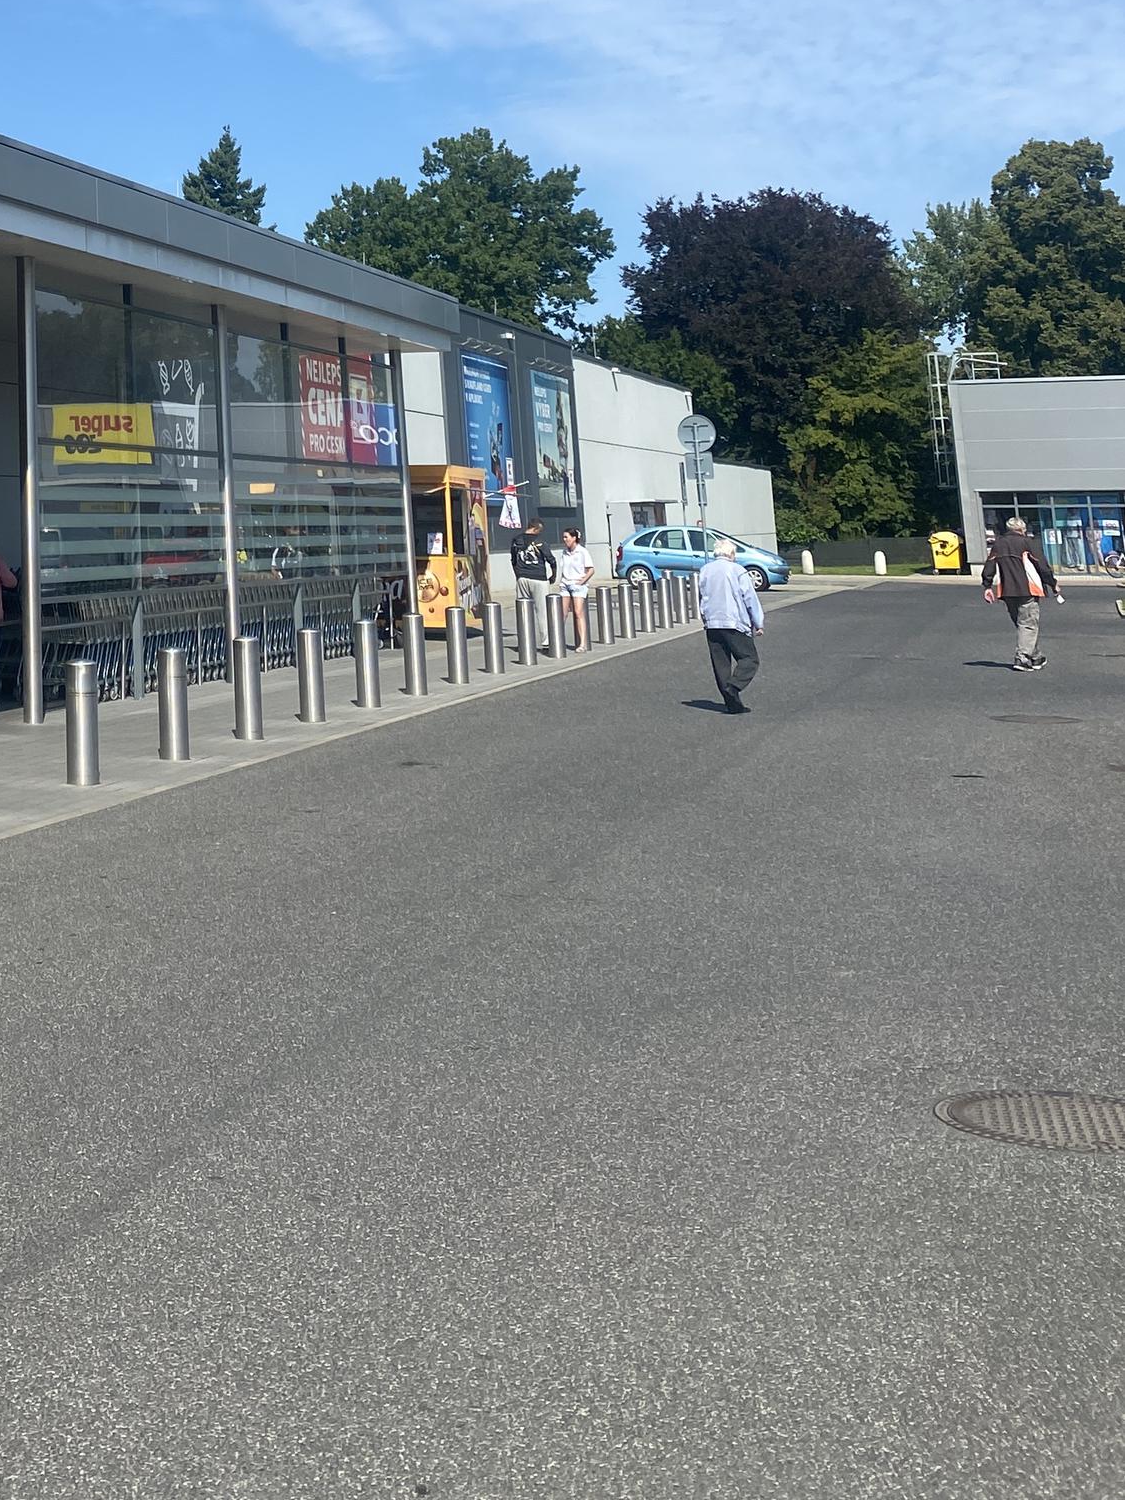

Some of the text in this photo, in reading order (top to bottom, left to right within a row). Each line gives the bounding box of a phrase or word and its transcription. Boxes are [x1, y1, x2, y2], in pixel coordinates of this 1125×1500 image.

[306, 358, 342, 387] NEJLEPŠ
[308, 387, 344, 428] CENA
[309, 433, 326, 452] PRO
